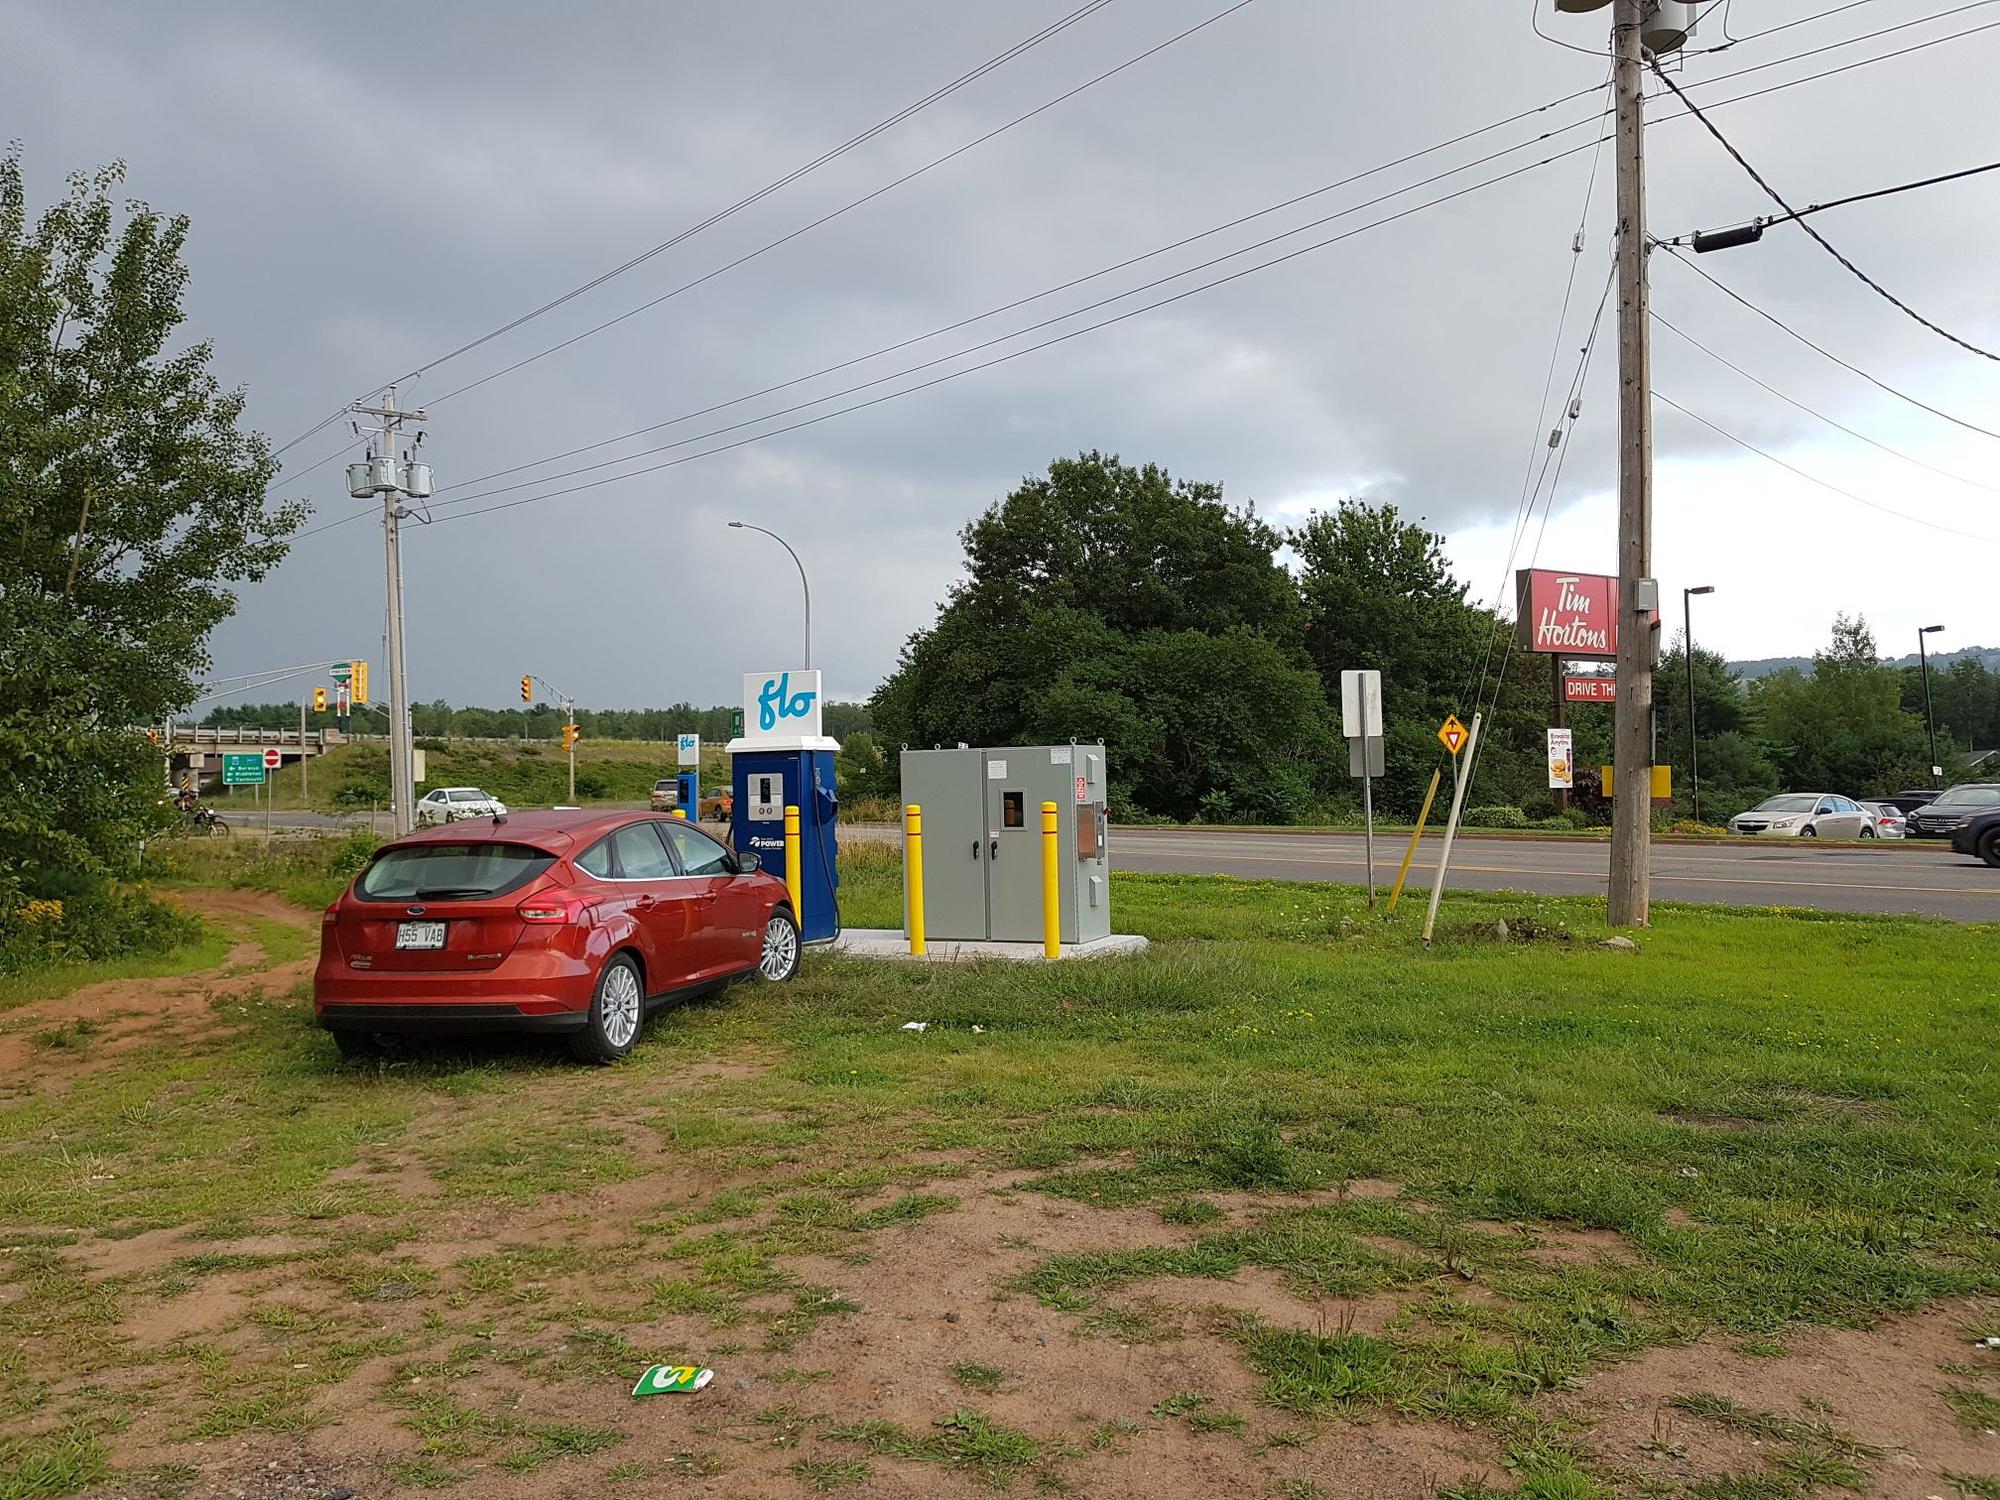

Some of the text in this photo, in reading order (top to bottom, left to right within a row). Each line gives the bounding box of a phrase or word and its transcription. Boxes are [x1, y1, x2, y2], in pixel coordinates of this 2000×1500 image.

[1555, 577, 1590, 614] Tim
[1537, 606, 1606, 649] Hortons
[757, 672, 816, 731] flo
[1568, 681, 1597, 696] DRIVE
[680, 735, 696, 751] flo
[398, 928, 443, 943] H55 VAB
